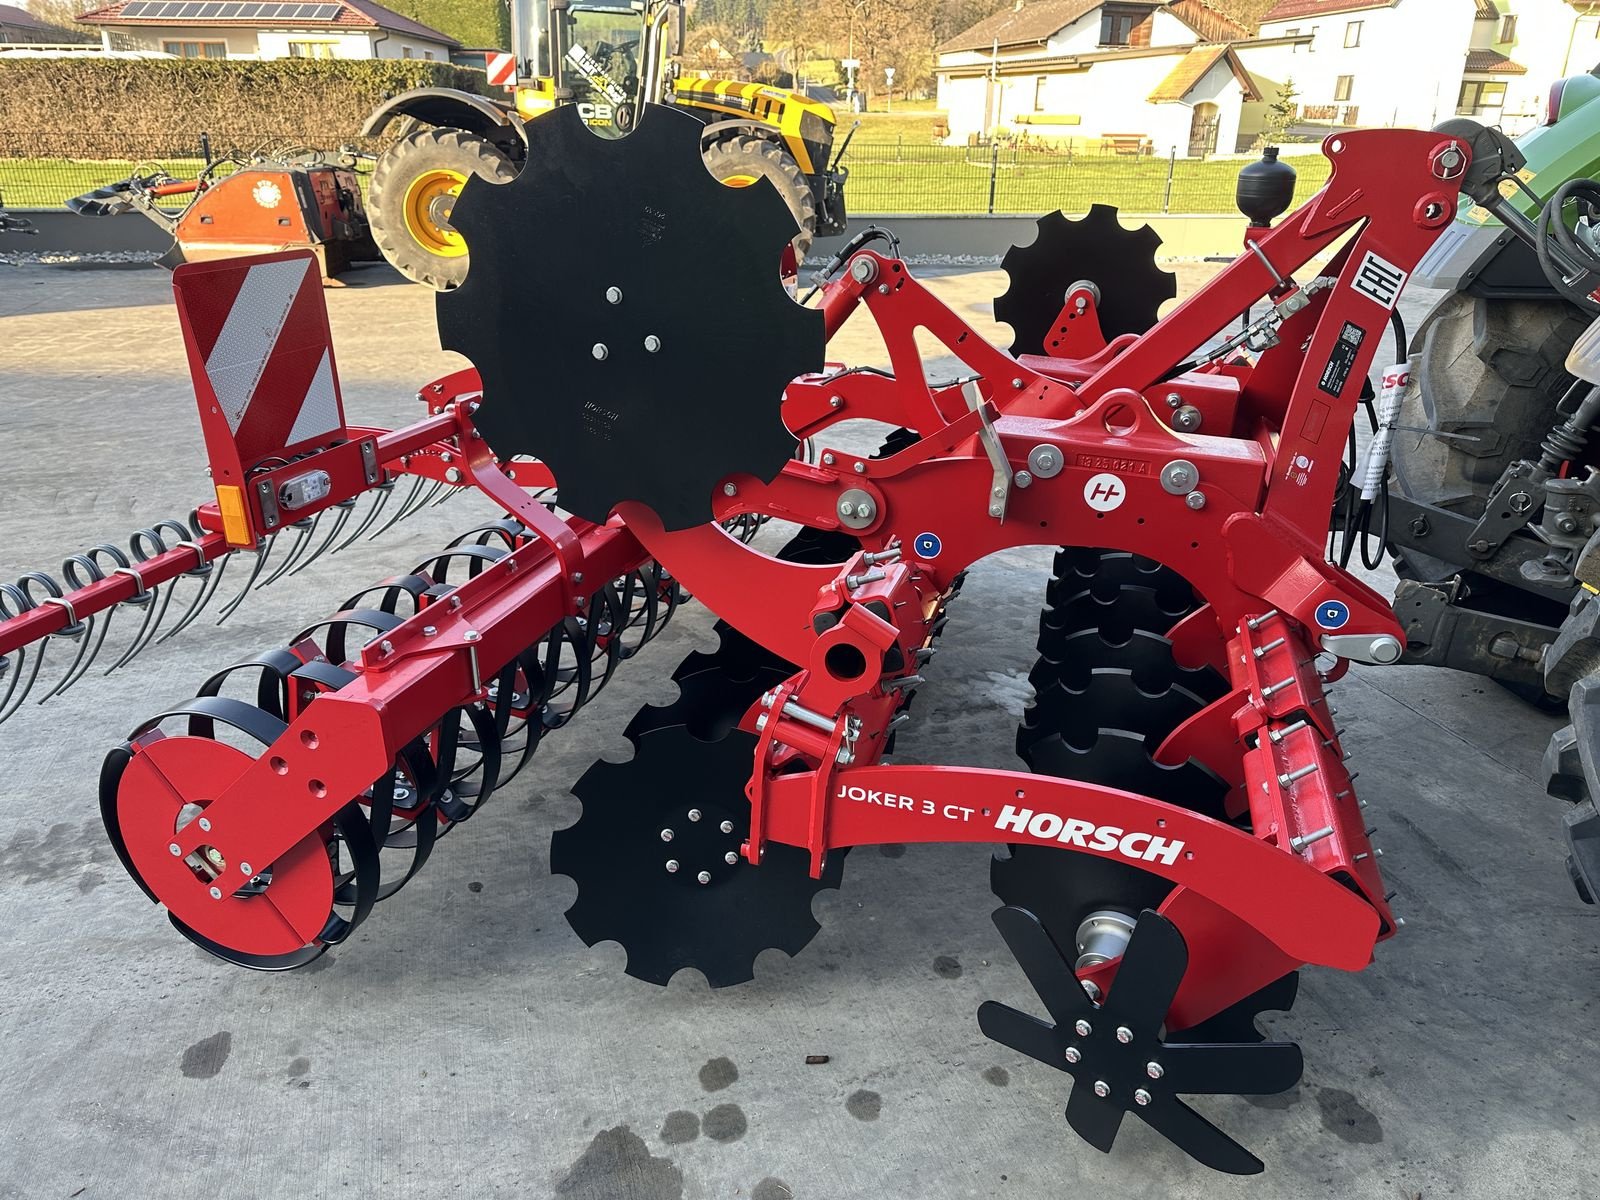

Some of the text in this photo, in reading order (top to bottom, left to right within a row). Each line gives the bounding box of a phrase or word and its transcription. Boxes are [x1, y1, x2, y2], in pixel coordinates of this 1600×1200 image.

[577, 103, 613, 119] CB
[837, 785, 975, 822] JOKER 3 CT
[994, 804, 1185, 866] HORSCH
